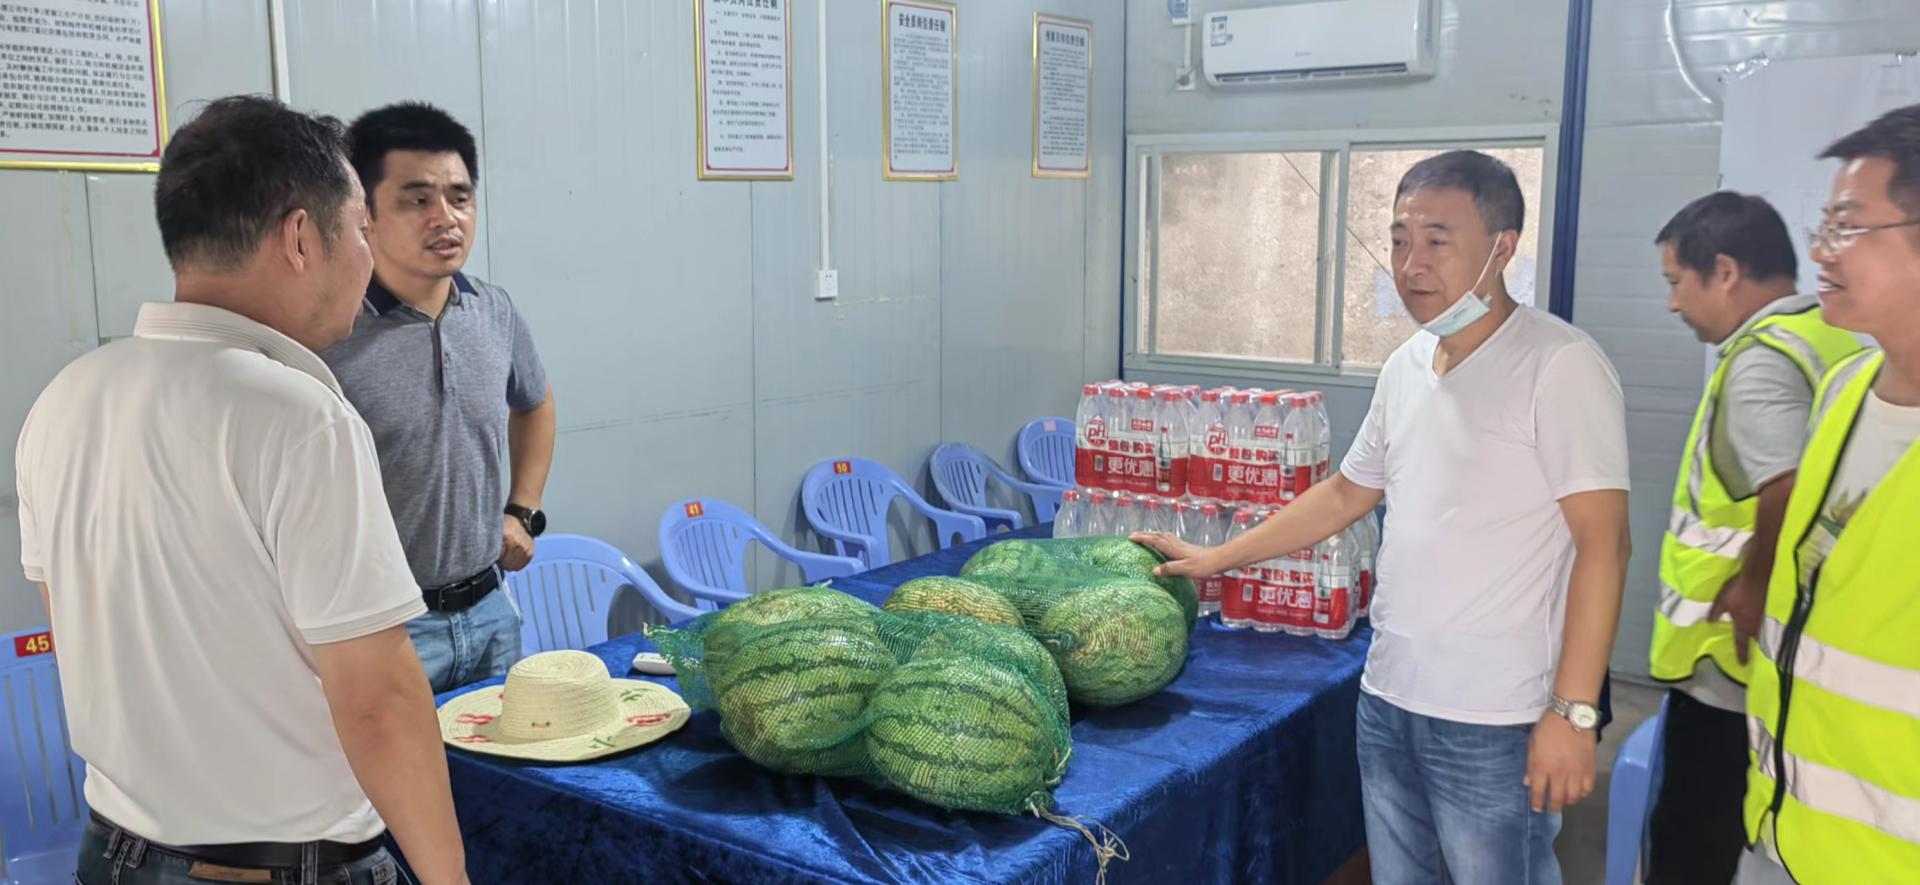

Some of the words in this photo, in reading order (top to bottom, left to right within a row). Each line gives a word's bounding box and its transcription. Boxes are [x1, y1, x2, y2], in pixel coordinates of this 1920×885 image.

[1088, 423, 1107, 439] pH
[1209, 430, 1226, 447] pH
[1107, 456, 1155, 477] 更优惠
[1227, 465, 1278, 486] 更优惠
[1258, 585, 1313, 609] 更优惠
[26, 634, 50, 653] 45
